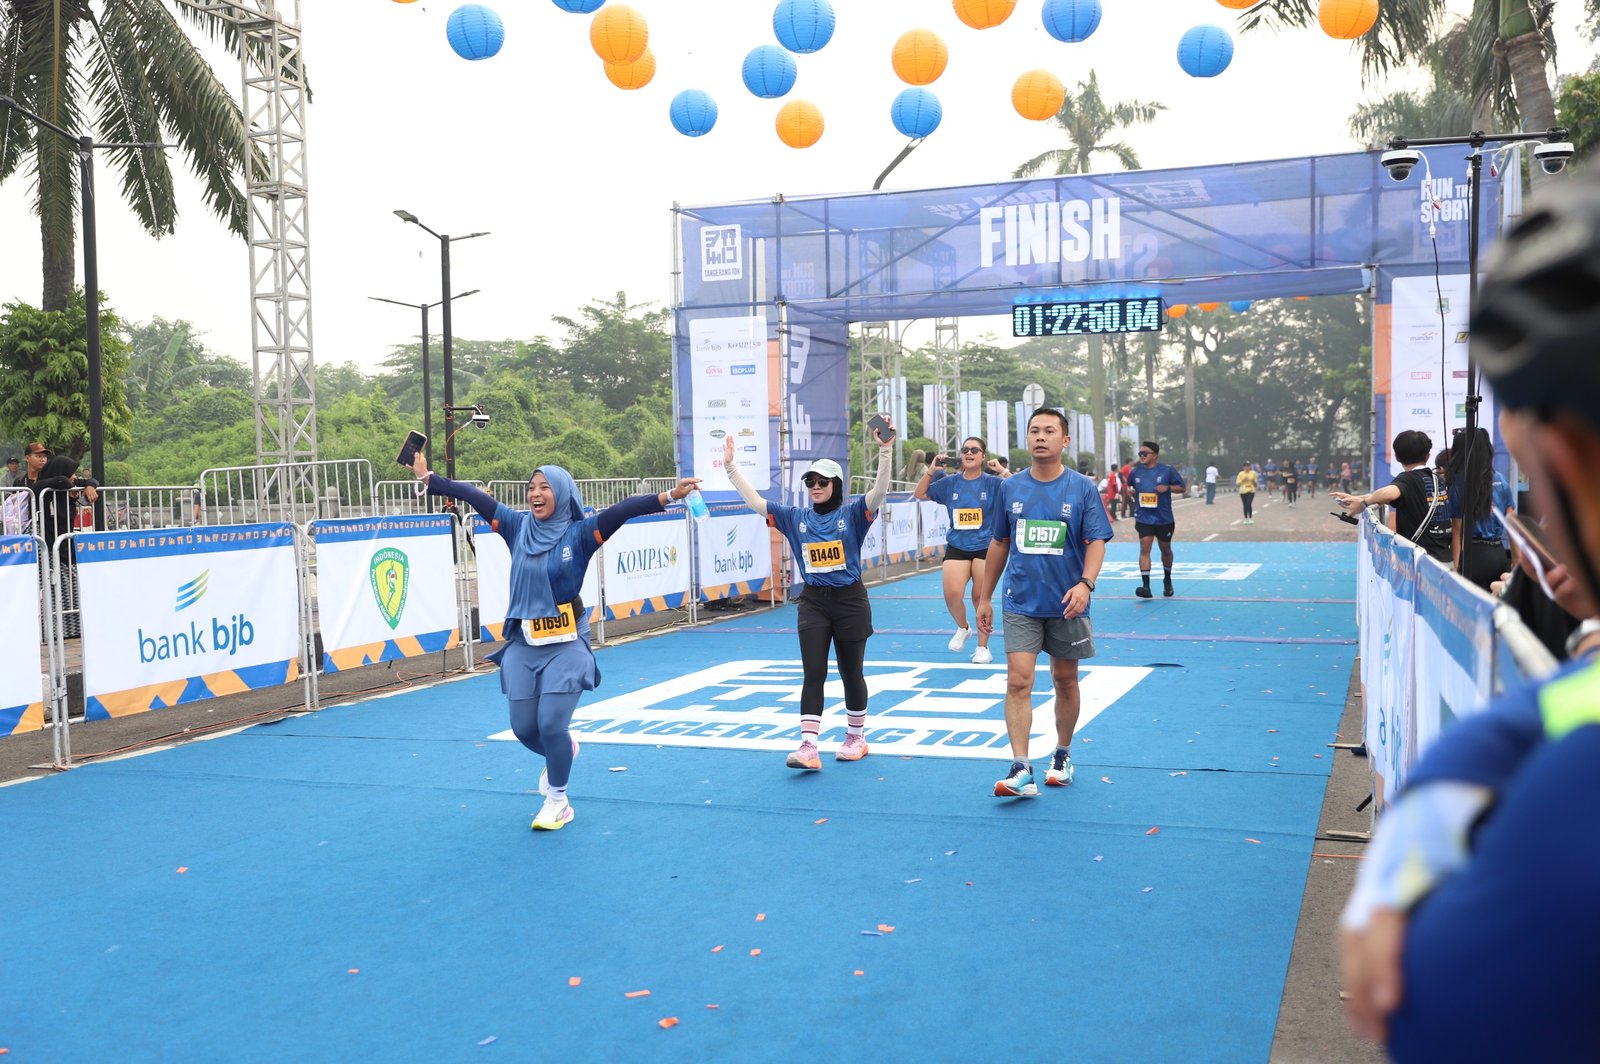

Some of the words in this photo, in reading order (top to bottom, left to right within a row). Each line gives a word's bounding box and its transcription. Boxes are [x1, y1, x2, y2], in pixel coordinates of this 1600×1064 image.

[1421, 178, 1452, 200] RUN
[980, 197, 1120, 268] FINISH
[704, 268, 732, 277] TANGERANG
[1013, 300, 1159, 336] 01:22:50.64
[960, 512, 980, 522] B2641
[1028, 526, 1060, 542] C1517
[374, 551, 404, 564] INDONESIA
[616, 546, 670, 574] KOMPAS
[714, 552, 738, 573] bank
[738, 550, 754, 573] bjb
[810, 546, 840, 562] B1440
[532, 612, 570, 632] B1690
[138, 622, 206, 664] bank
[212, 614, 254, 656] bjb
